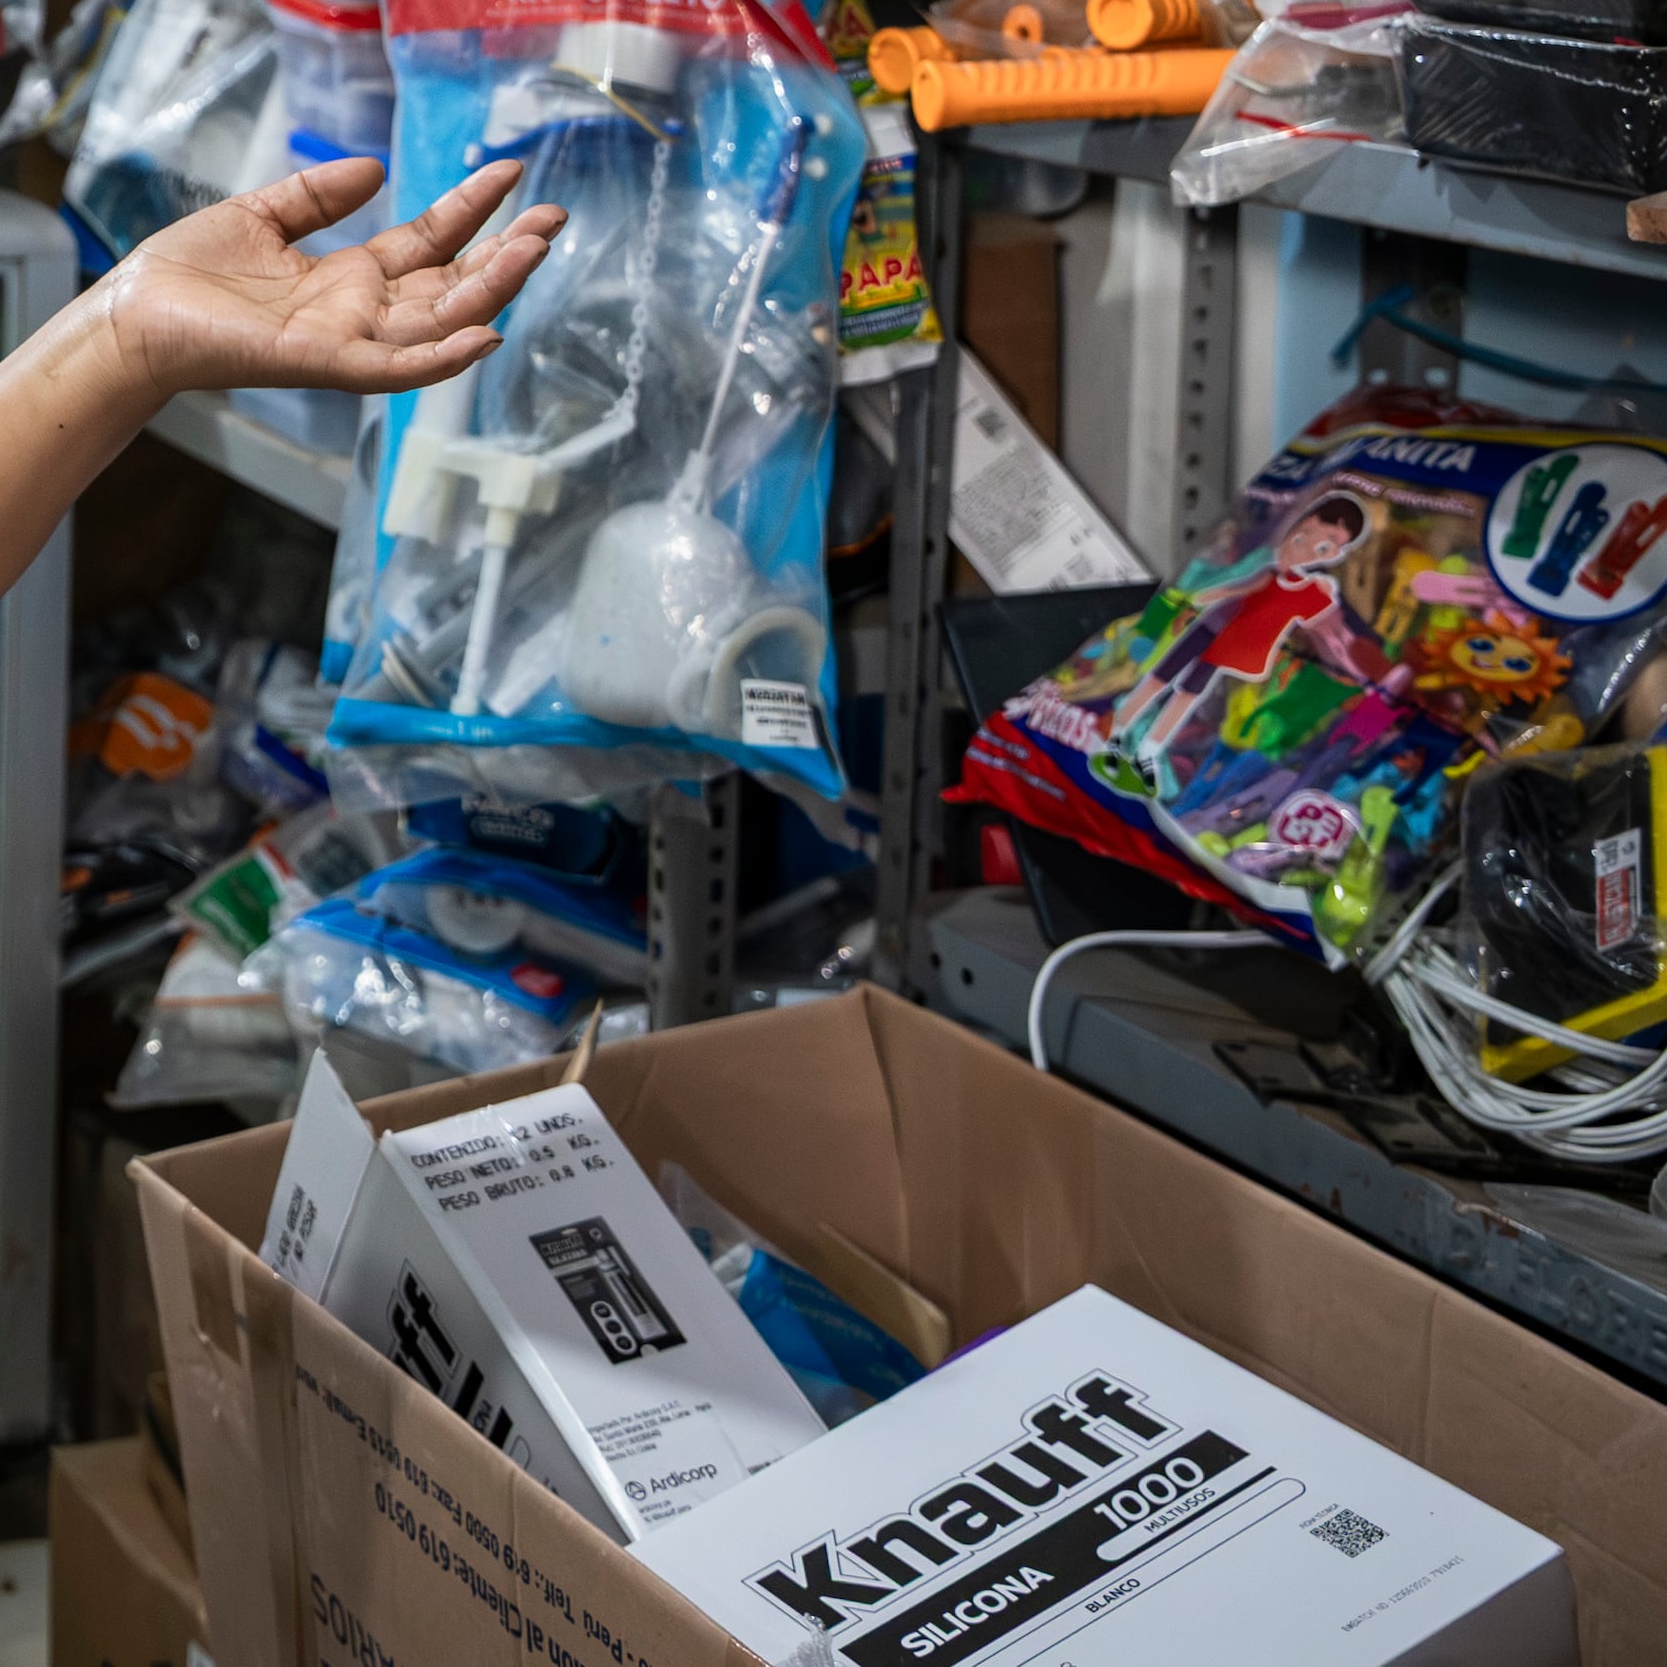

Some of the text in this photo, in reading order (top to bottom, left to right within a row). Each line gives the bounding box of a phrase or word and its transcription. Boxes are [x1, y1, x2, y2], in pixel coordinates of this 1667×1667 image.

[411, 1135, 505, 1167] CONTENIDO:
[424, 1168, 465, 1191] PESO
[473, 1157, 520, 1181] NETO:
[529, 1145, 556, 1163] 0.5
[438, 1190, 481, 1213] PESO
[483, 1174, 545, 1202] BRUTO:
[650, 1462, 718, 1495] Ardicorp
[1093, 1455, 1206, 1532] 1000
[374, 1481, 418, 1542] 0510
[752, 1374, 1171, 1632] Knauff
[1144, 1486, 1217, 1534] MULTIUSOS
[418, 1523, 451, 1572] 619
[452, 1554, 524, 1639] Cliente:
[900, 1564, 1056, 1659] SILICONA
[1085, 1577, 1142, 1615] BLANCO
